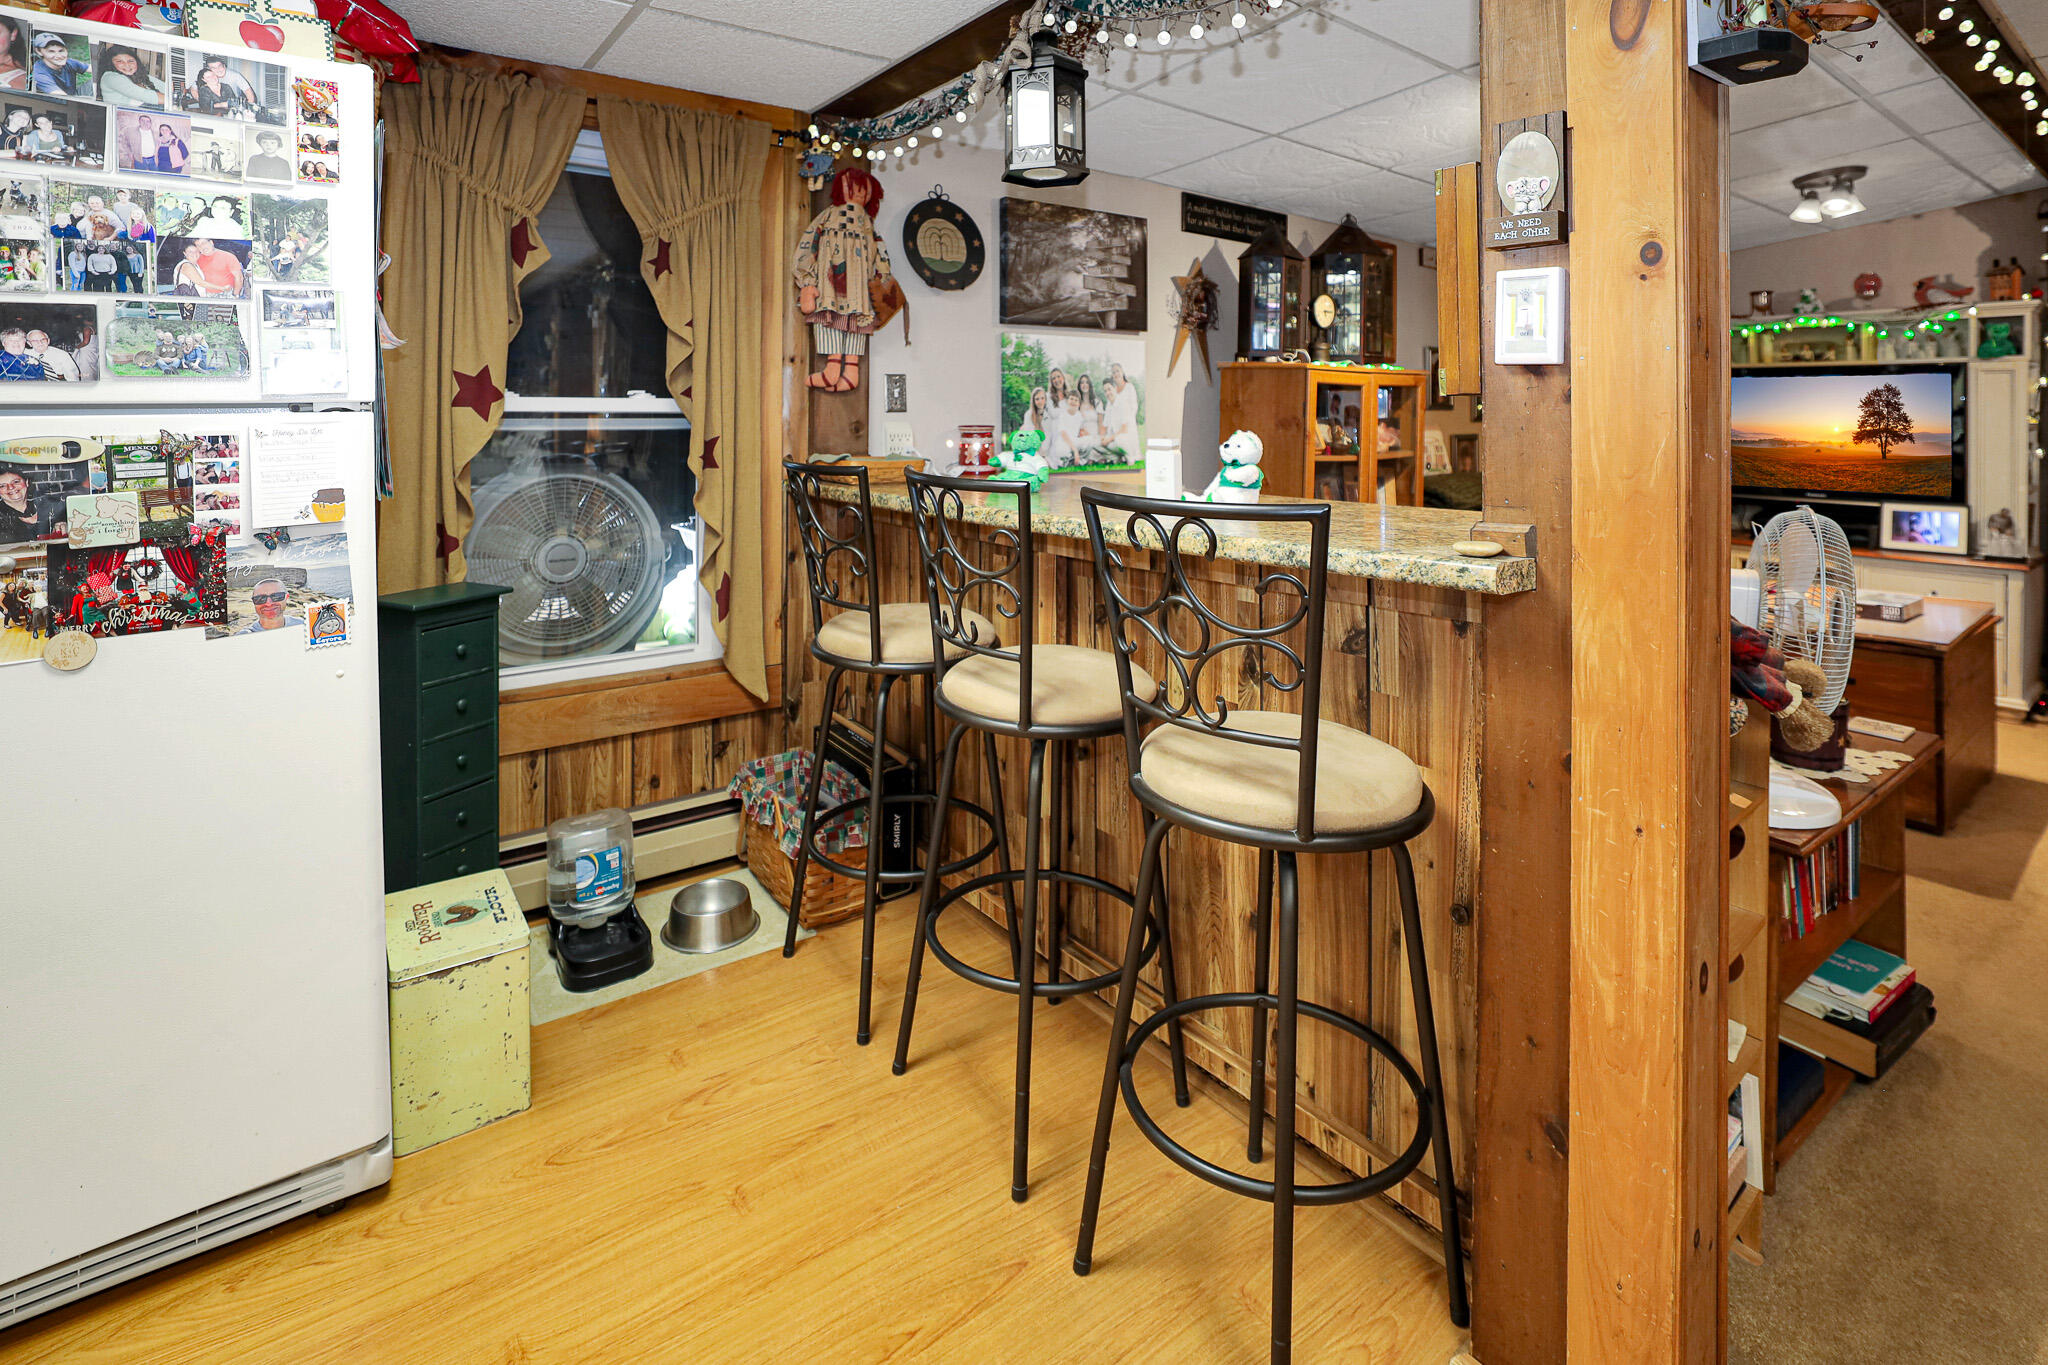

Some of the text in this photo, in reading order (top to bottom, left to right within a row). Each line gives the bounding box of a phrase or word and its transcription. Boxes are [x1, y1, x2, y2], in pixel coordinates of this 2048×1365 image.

[1494, 227, 1550, 240] EACH OTHER
[1500, 218, 1541, 229] WE NEED
[0, 445, 58, 455] LIFORNIA
[58, 622, 97, 634] MERRY
[198, 609, 220, 621] 2025
[893, 813, 901, 849] SMIRLY
[484, 886, 508, 924] FLOUR
[412, 900, 441, 945] ROOSTER
